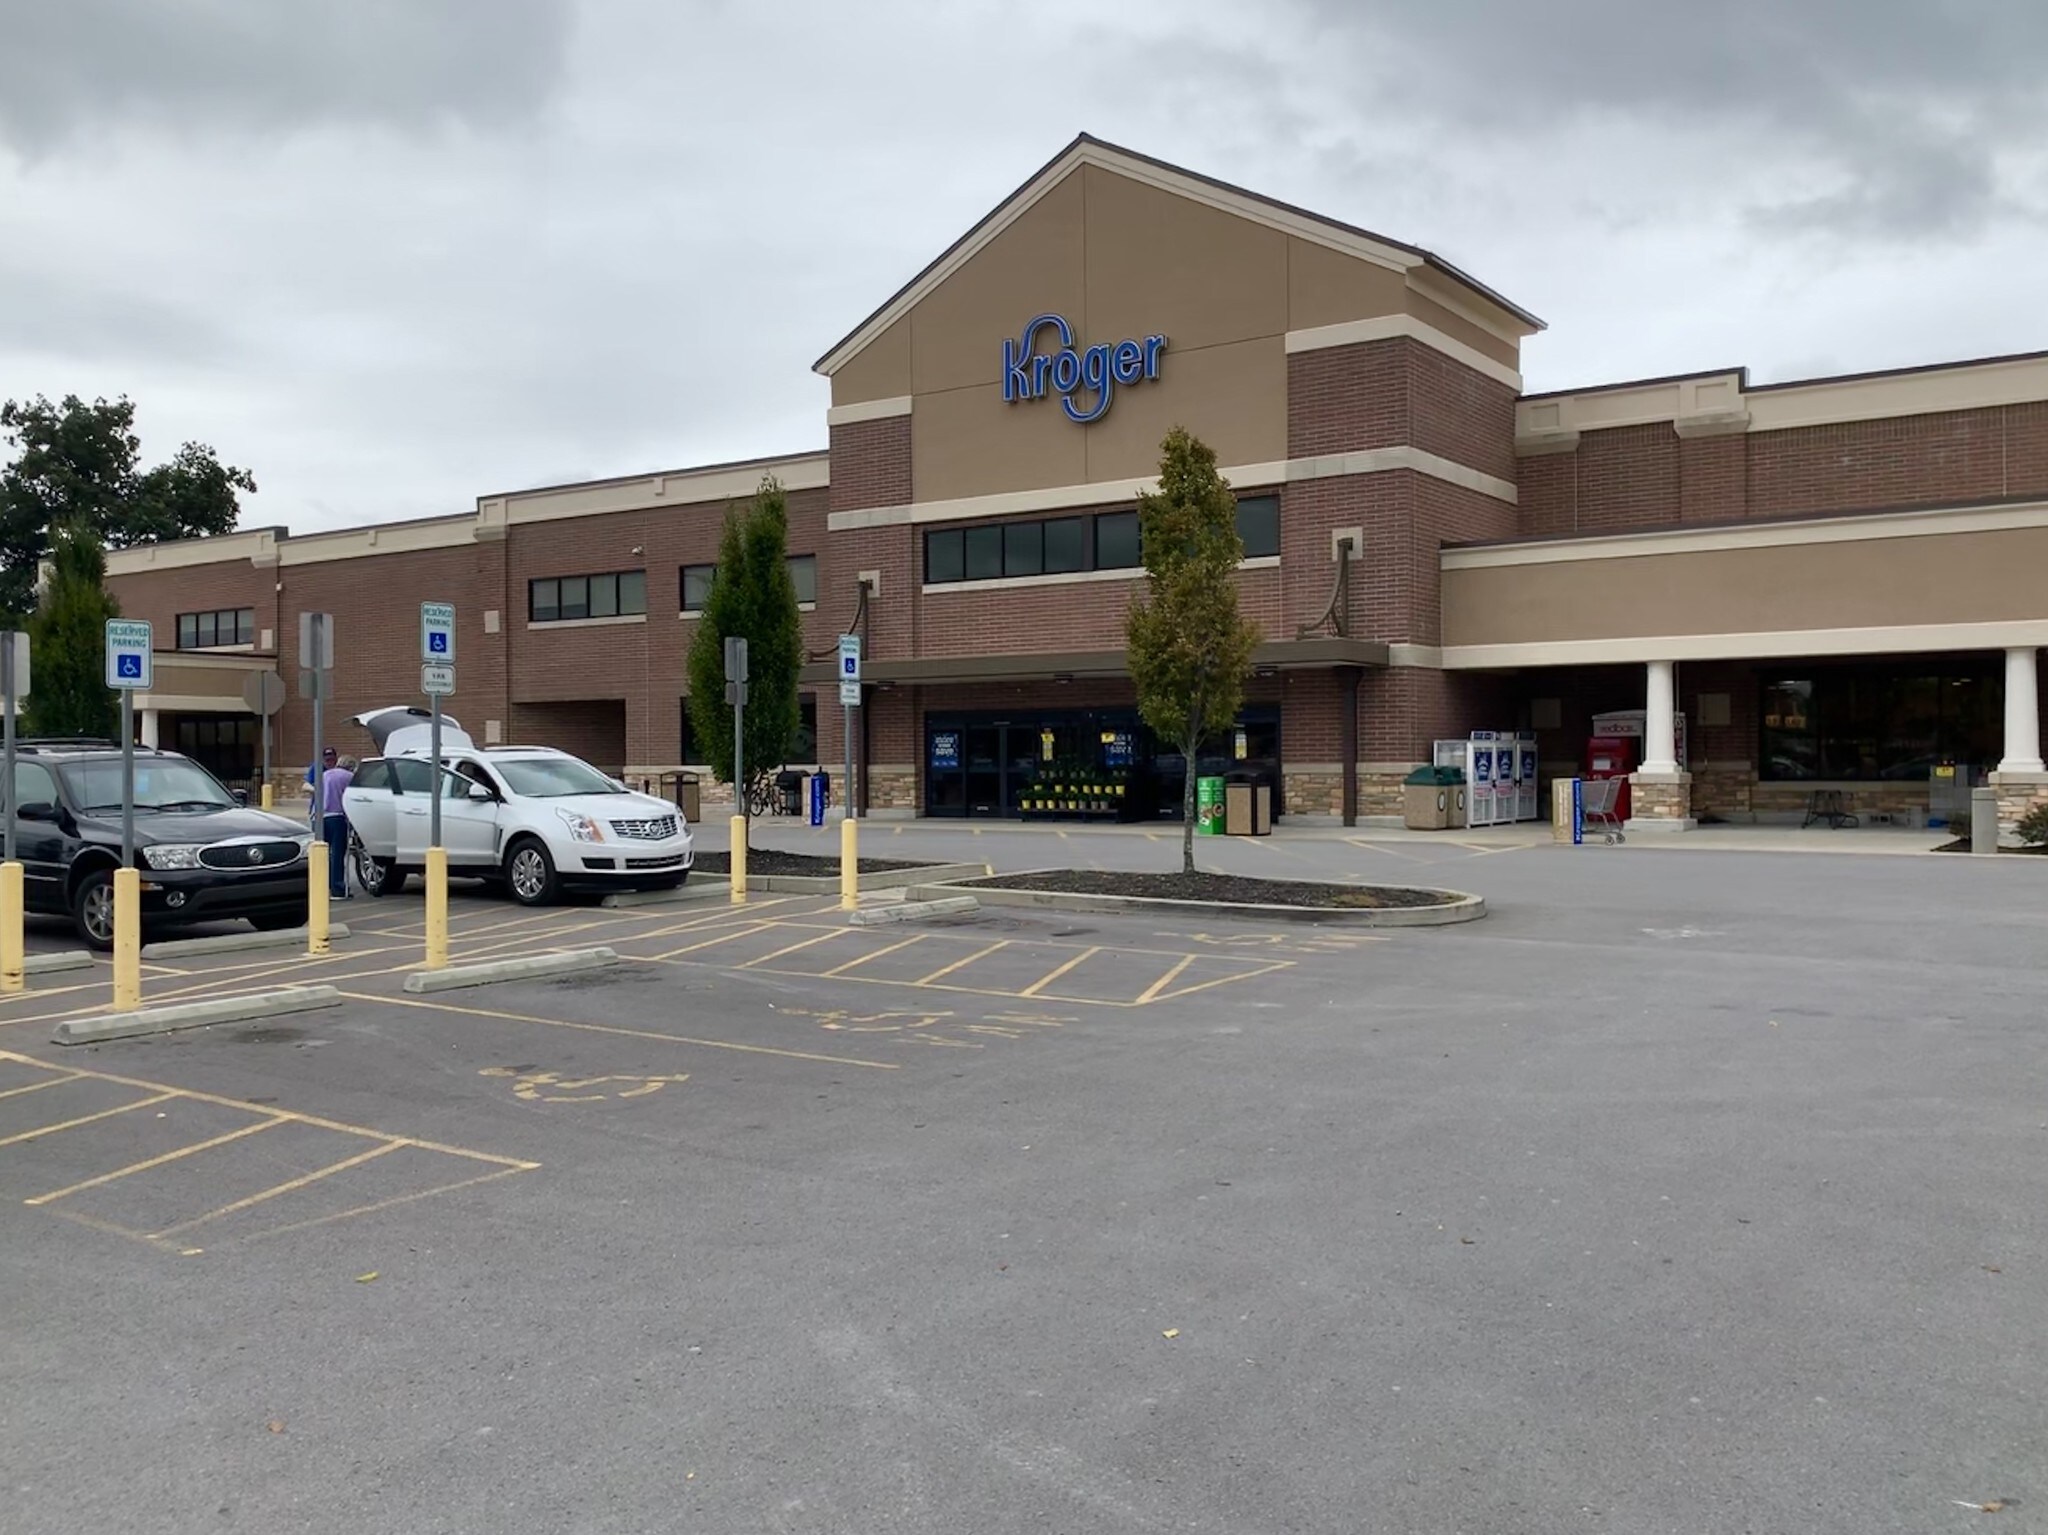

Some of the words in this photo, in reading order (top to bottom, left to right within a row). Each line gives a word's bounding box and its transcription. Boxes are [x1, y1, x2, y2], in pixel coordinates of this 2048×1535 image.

[1002, 313, 1167, 422] Kroger
[110, 625, 148, 636] RESERVED
[112, 638, 146, 648] PARKING
